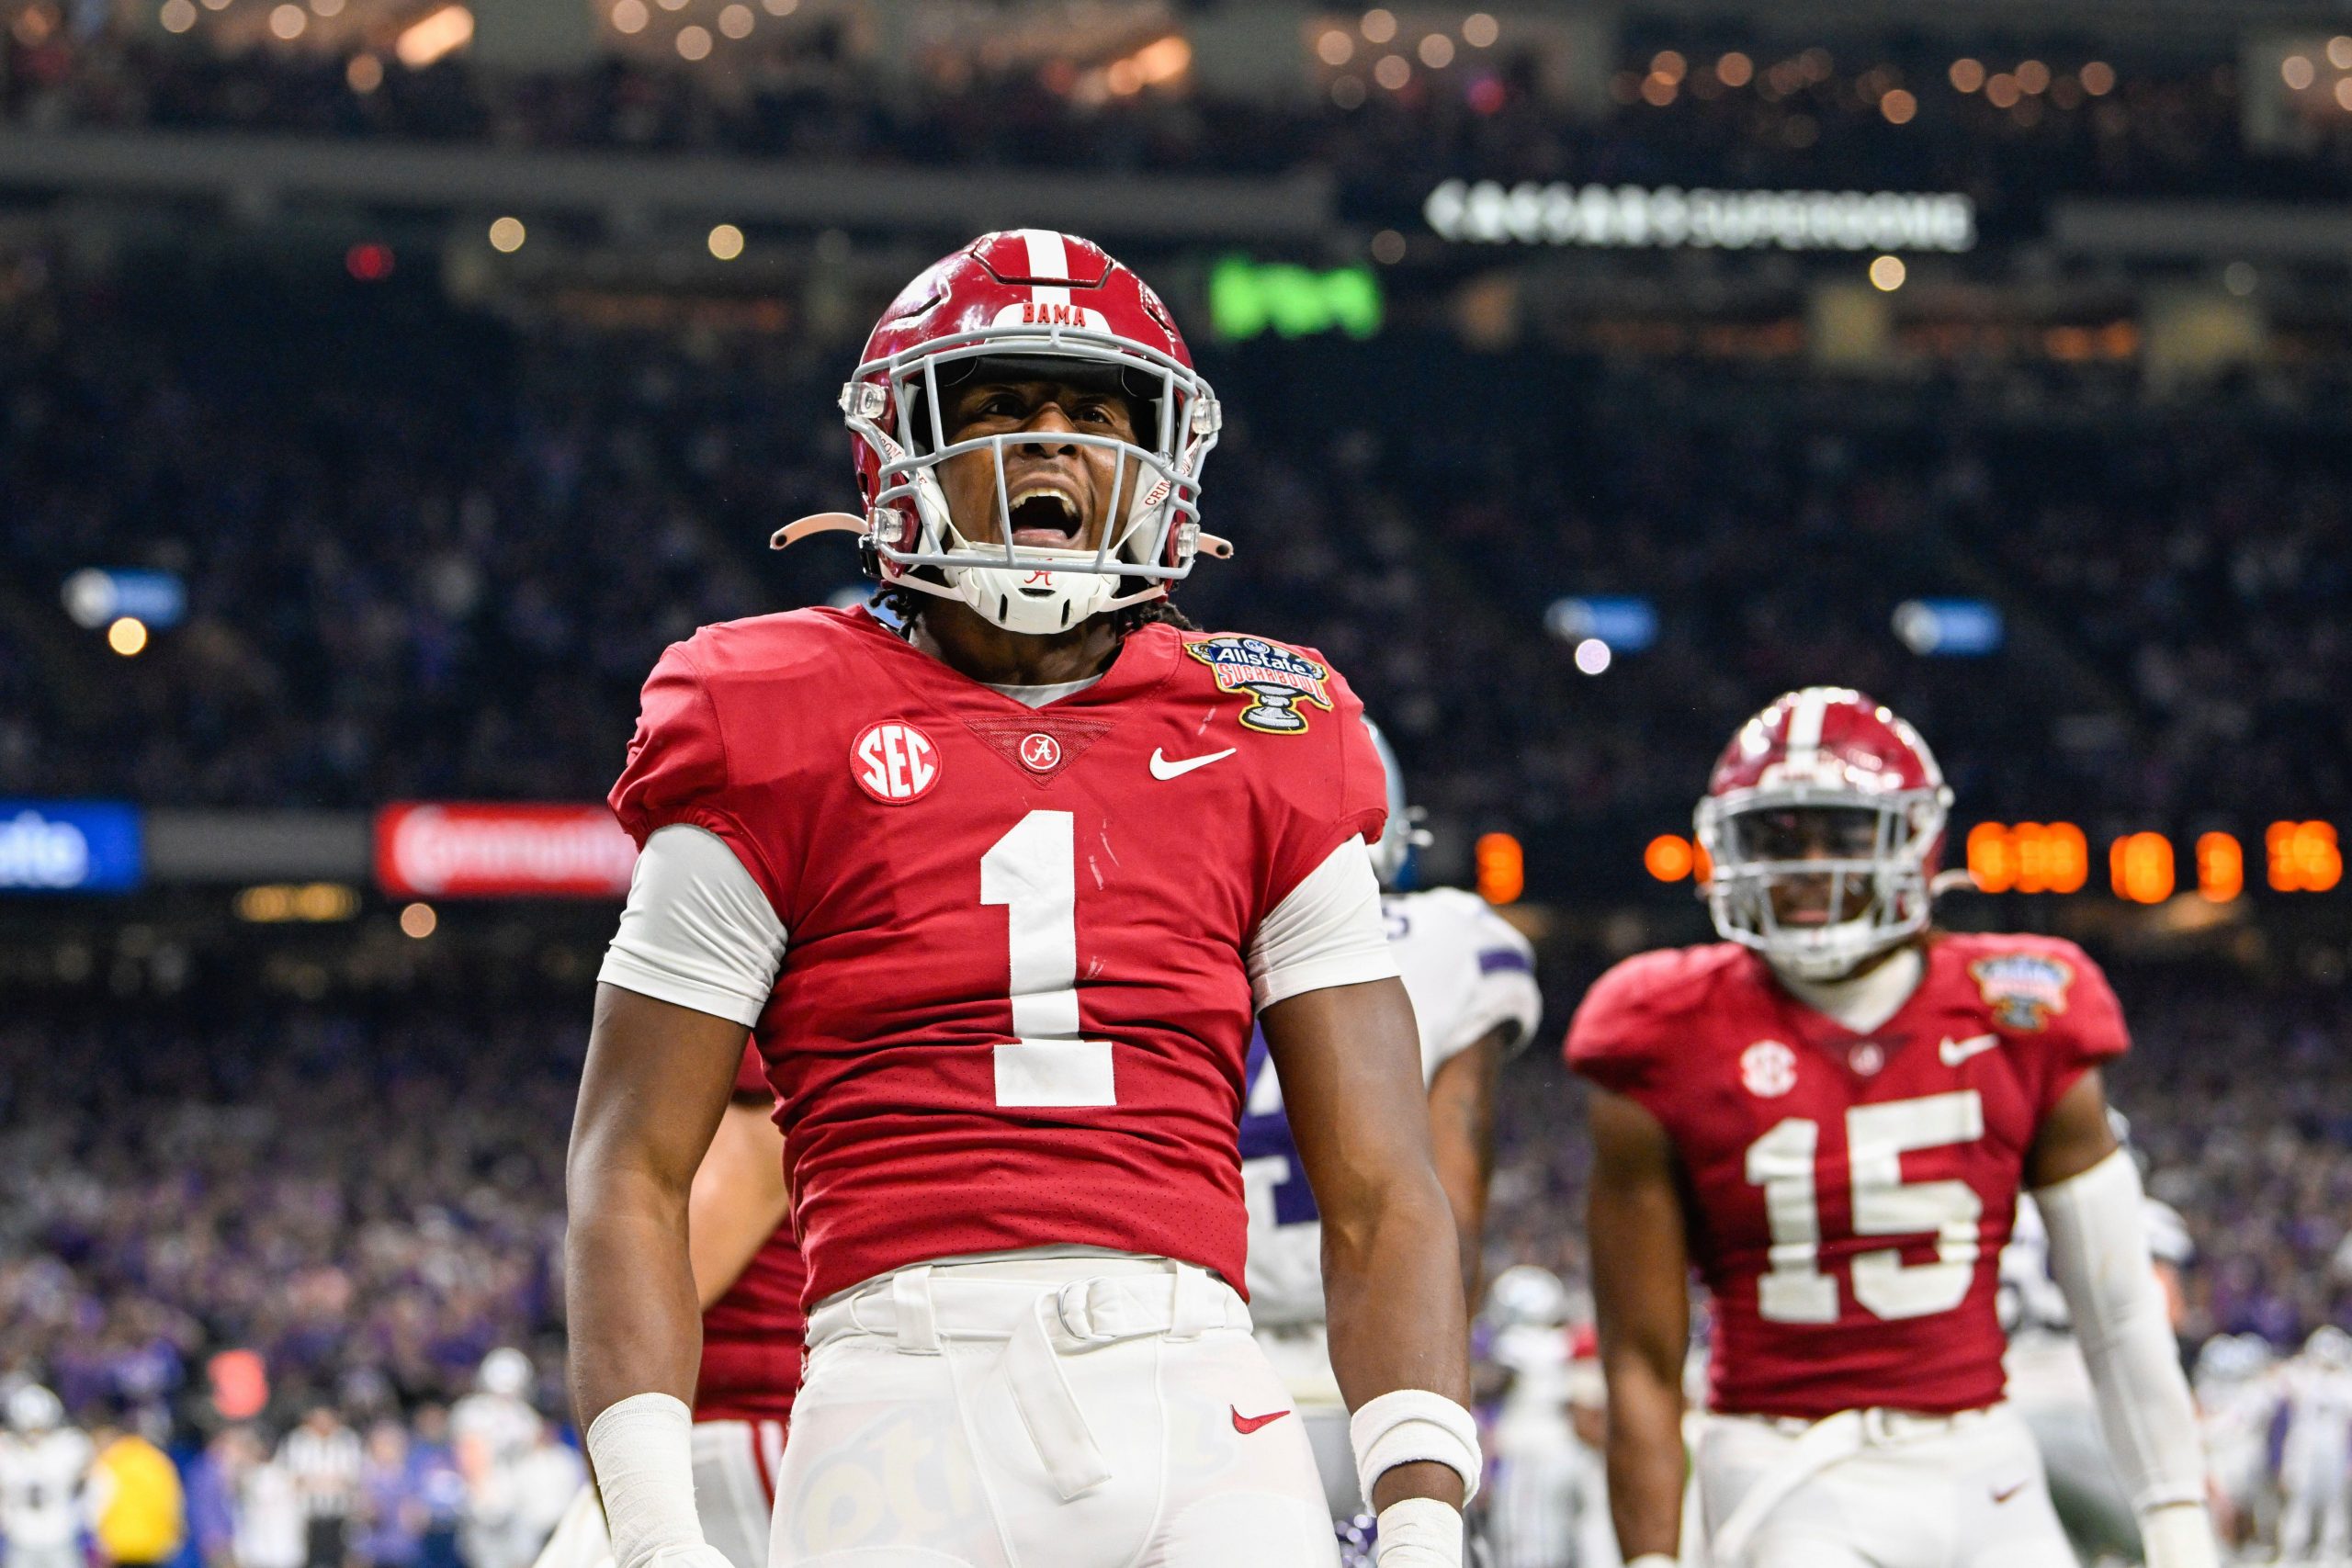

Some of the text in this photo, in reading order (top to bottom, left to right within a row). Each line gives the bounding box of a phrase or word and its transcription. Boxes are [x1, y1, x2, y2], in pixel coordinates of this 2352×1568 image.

[1023, 301, 1086, 328] BAMA
[1217, 648, 1306, 676] Allstate
[857, 725, 933, 797] SEC
[979, 809, 1117, 1108] 1
[1747, 1089, 1984, 1324] 15
